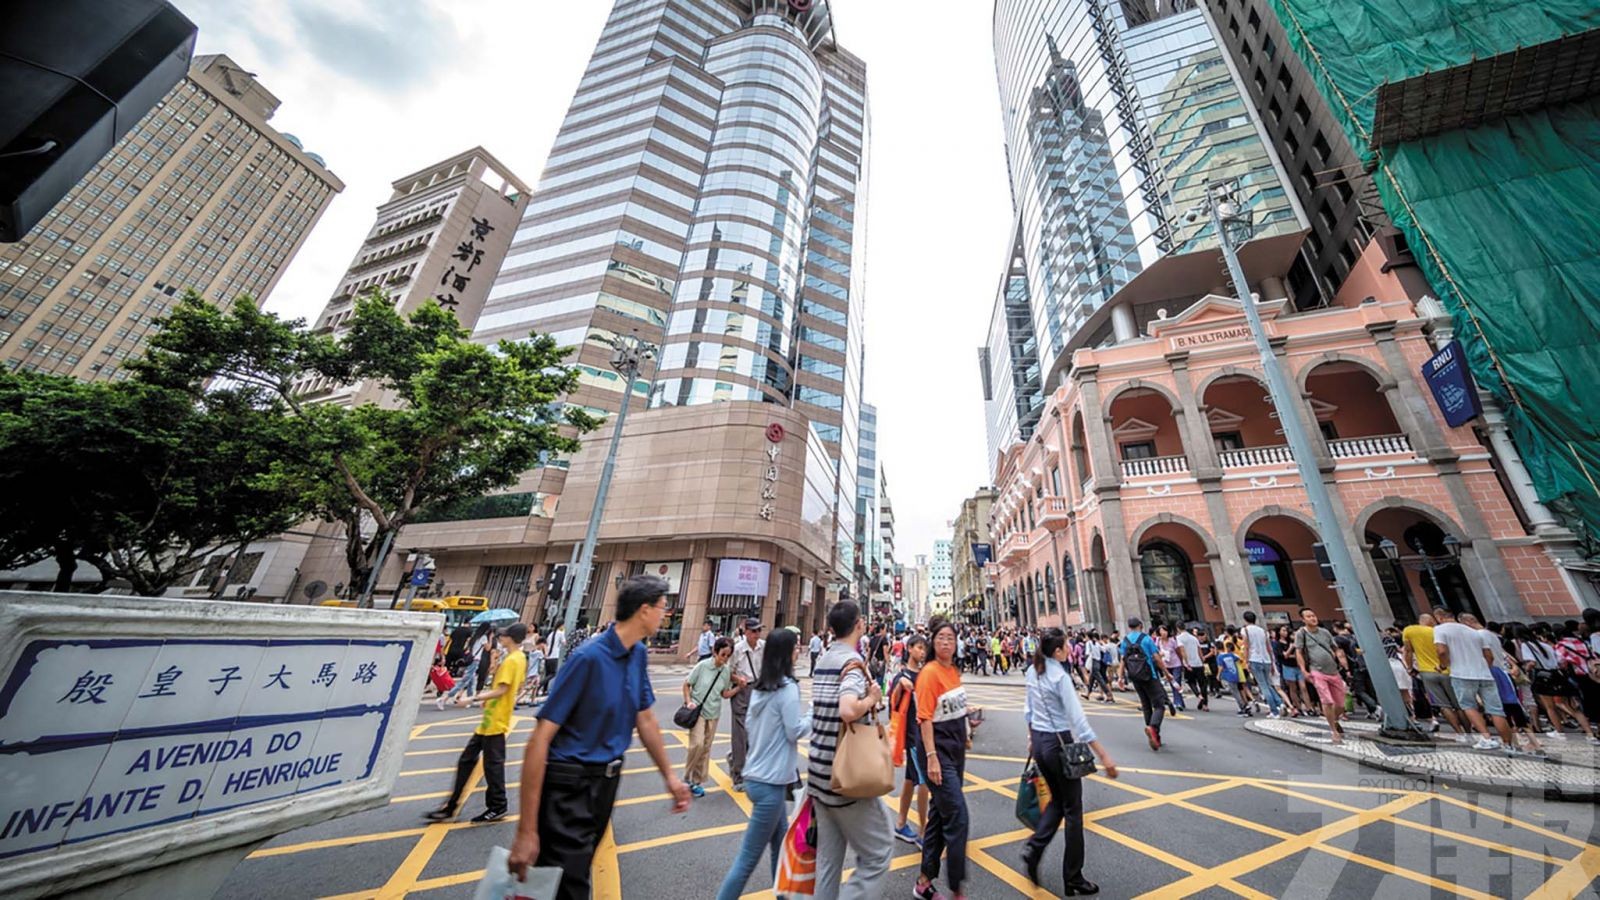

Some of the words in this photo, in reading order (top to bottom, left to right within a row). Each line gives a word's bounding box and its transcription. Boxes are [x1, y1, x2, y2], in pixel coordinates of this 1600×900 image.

[1199, 327, 1253, 344] ULTRAMARI
[1432, 348, 1452, 370] BNU
[56, 661, 378, 704] 殷皇子大馬路
[126, 737, 253, 775] AVENIDA
[266, 731, 302, 755] DO
[0, 785, 166, 840] INFANTE
[177, 779, 205, 804] D.
[222, 753, 343, 795] HENRIQUE
